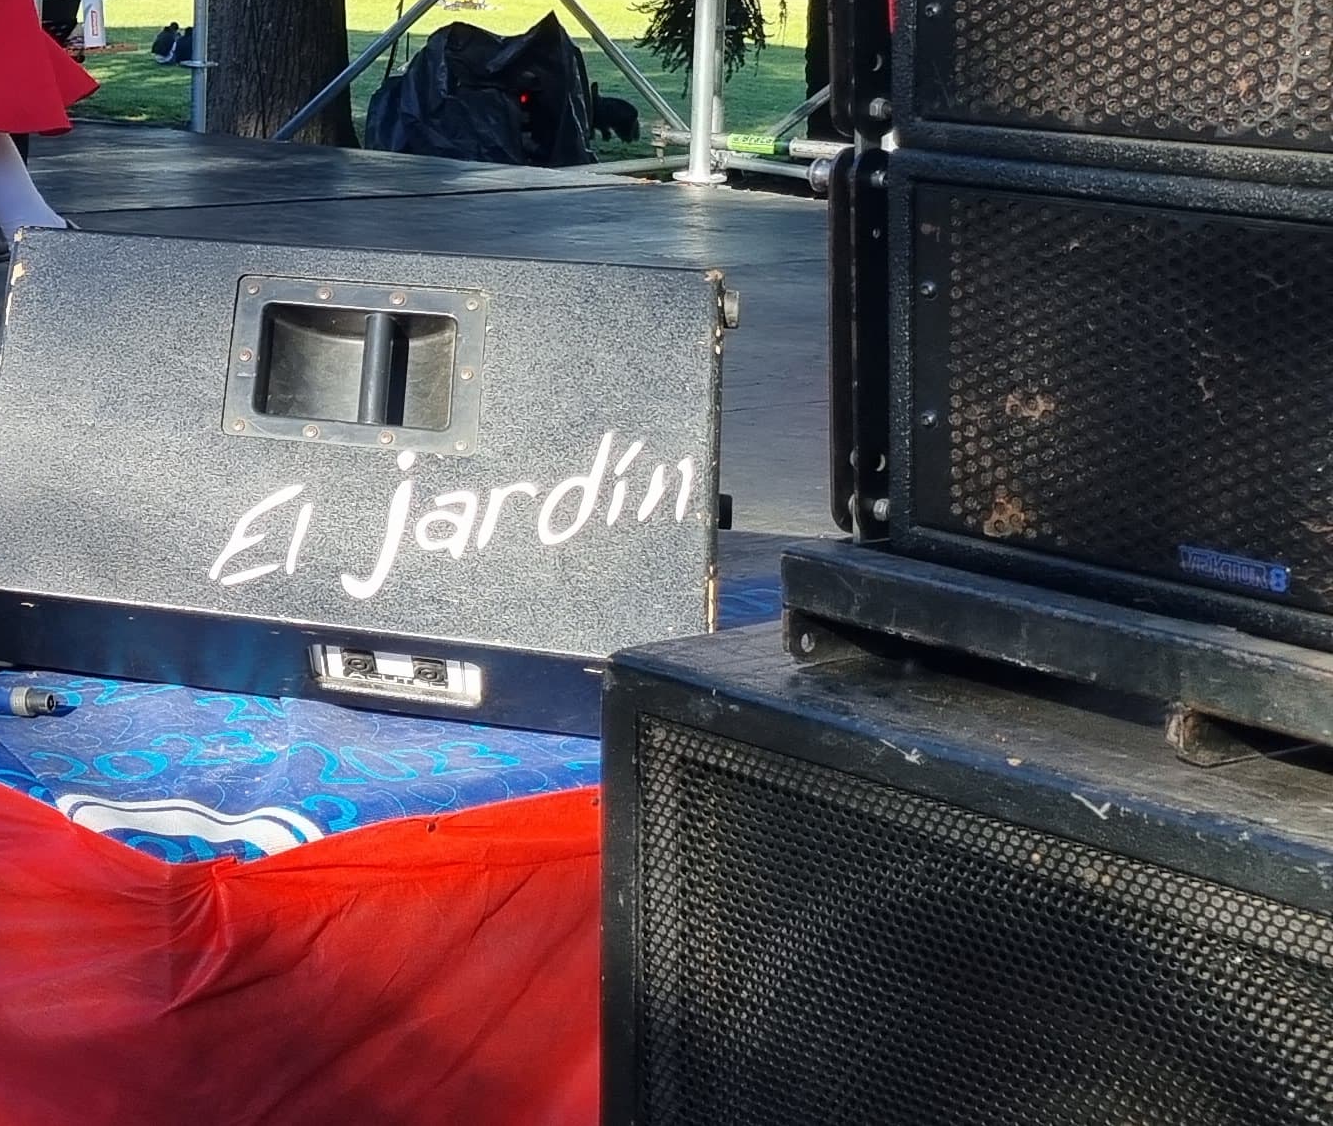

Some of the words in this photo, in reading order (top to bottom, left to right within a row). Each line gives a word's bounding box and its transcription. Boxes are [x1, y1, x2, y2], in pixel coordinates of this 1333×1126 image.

[208, 482, 316, 585] El
[340, 430, 693, 601] jardín
[29, 731, 277, 786] 2023
[286, 740, 521, 785] 2023
